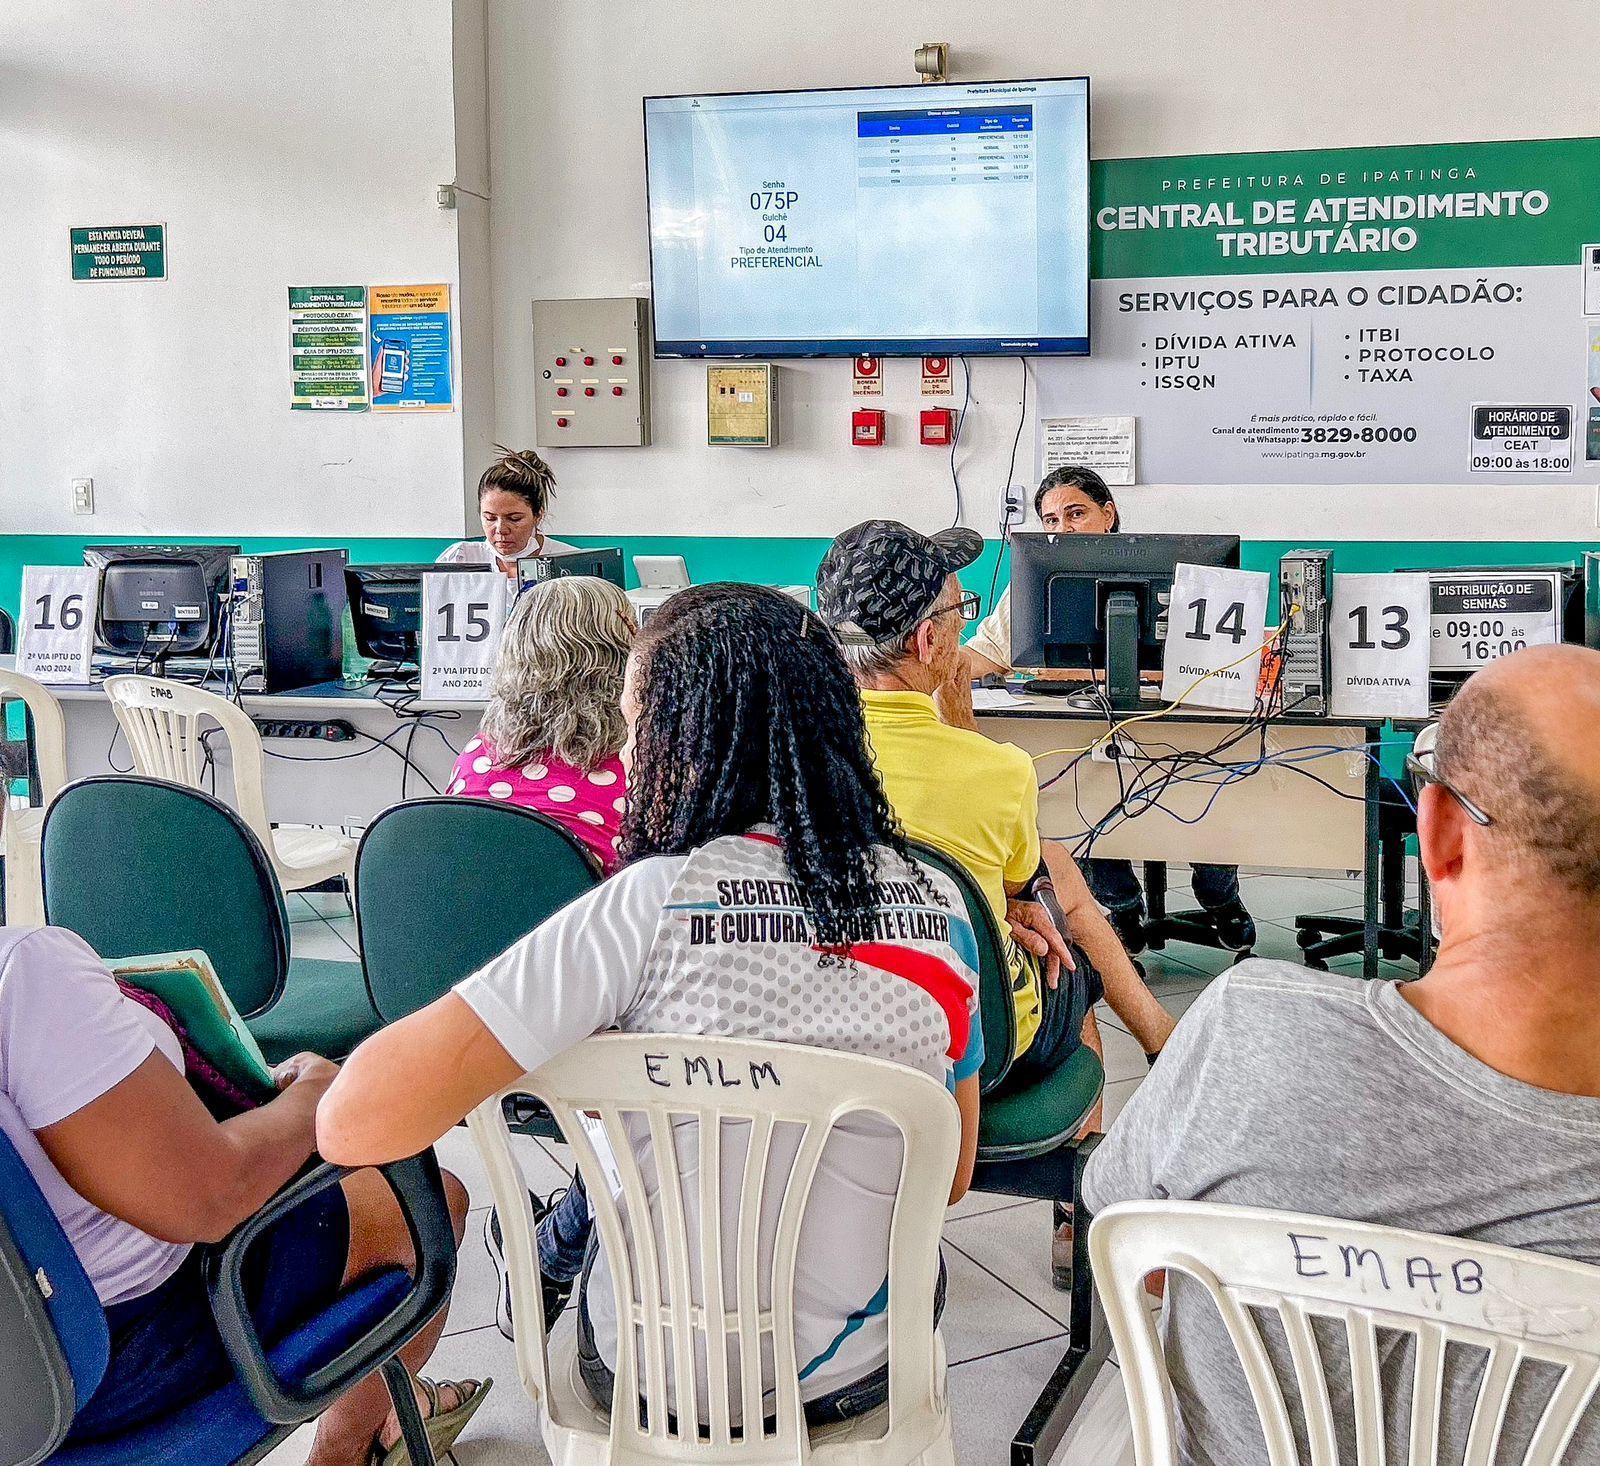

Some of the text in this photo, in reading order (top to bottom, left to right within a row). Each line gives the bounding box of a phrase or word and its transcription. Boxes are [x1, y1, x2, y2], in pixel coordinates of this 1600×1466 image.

[762, 180, 785, 189] Senha
[1162, 167, 1477, 191] PREFEITURA DE IPATINGA
[750, 191, 799, 210] 075P
[1096, 189, 1550, 231] CENTRAL DE ATENDIMENTO
[88, 228, 145, 241] ESTA PORTA DEVERÁ
[764, 224, 788, 243] 04
[1215, 222, 1418, 257] TRIBUTÁRIO
[74, 241, 160, 254] PERMANECER ABERTA DURANTE
[739, 246, 814, 256] Tipo de Atendimento
[94, 253, 140, 265] TODO O PERÍODO
[730, 256, 823, 268] PREFERENCIAL
[90, 266, 146, 278] DE FUNCIONAMENTO
[1118, 278, 1523, 316] SERVIÇOS PARA O CIDADÃO:
[1155, 332, 1296, 350] DÍVIDA ATIVA
[1359, 328, 1400, 342] ITBI
[1359, 346, 1495, 362] PROTOCOLO
[1155, 356, 1200, 370] IPTU
[1358, 368, 1414, 382] TAXA
[1155, 374, 1216, 391] ISSQN
[1250, 414, 1257, 423] É
[1258, 414, 1280, 422] mais
[1282, 413, 1316, 424] prático,
[1317, 414, 1347, 424] rápido
[1488, 408, 1556, 422] HORÁRIO DE
[1212, 426, 1300, 434] Canal de atendimento
[1482, 425, 1560, 436] ATENDIMENTO
[1243, 436, 1300, 445] via Whatsapp:
[1504, 440, 1538, 450] CEAT
[1261, 450, 1366, 460] www.ipatinga.mg.gov.br
[1472, 456, 1570, 468] 09:00 às 18:00
[1438, 582, 1532, 598] DISTRIBUIÇÃO DE
[1462, 598, 1507, 609] SENHAS
[34, 594, 84, 630] 16
[438, 603, 491, 642] 15
[1185, 598, 1247, 644] 14
[1348, 604, 1411, 650] 13
[1430, 620, 1525, 638] e 09:00 às
[38, 652, 50, 661] VIA
[52, 652, 70, 661] IPTU
[70, 652, 82, 661] DO
[35, 664, 72, 673] ANO 2024
[443, 667, 458, 675] VIA
[460, 667, 478, 675] IPTU
[1179, 664, 1241, 680] DÍVIDA ATIVA
[442, 680, 483, 688] ANO 2024
[1346, 675, 1411, 687] DÍVIDA ATIVA
[150, 686, 174, 700] EMAB
[690, 914, 716, 945] DE
[721, 910, 813, 947] CULTURA,
[894, 910, 907, 940] E
[910, 910, 950, 943] LAZER
[1287, 1231, 1484, 1295] EMAB
